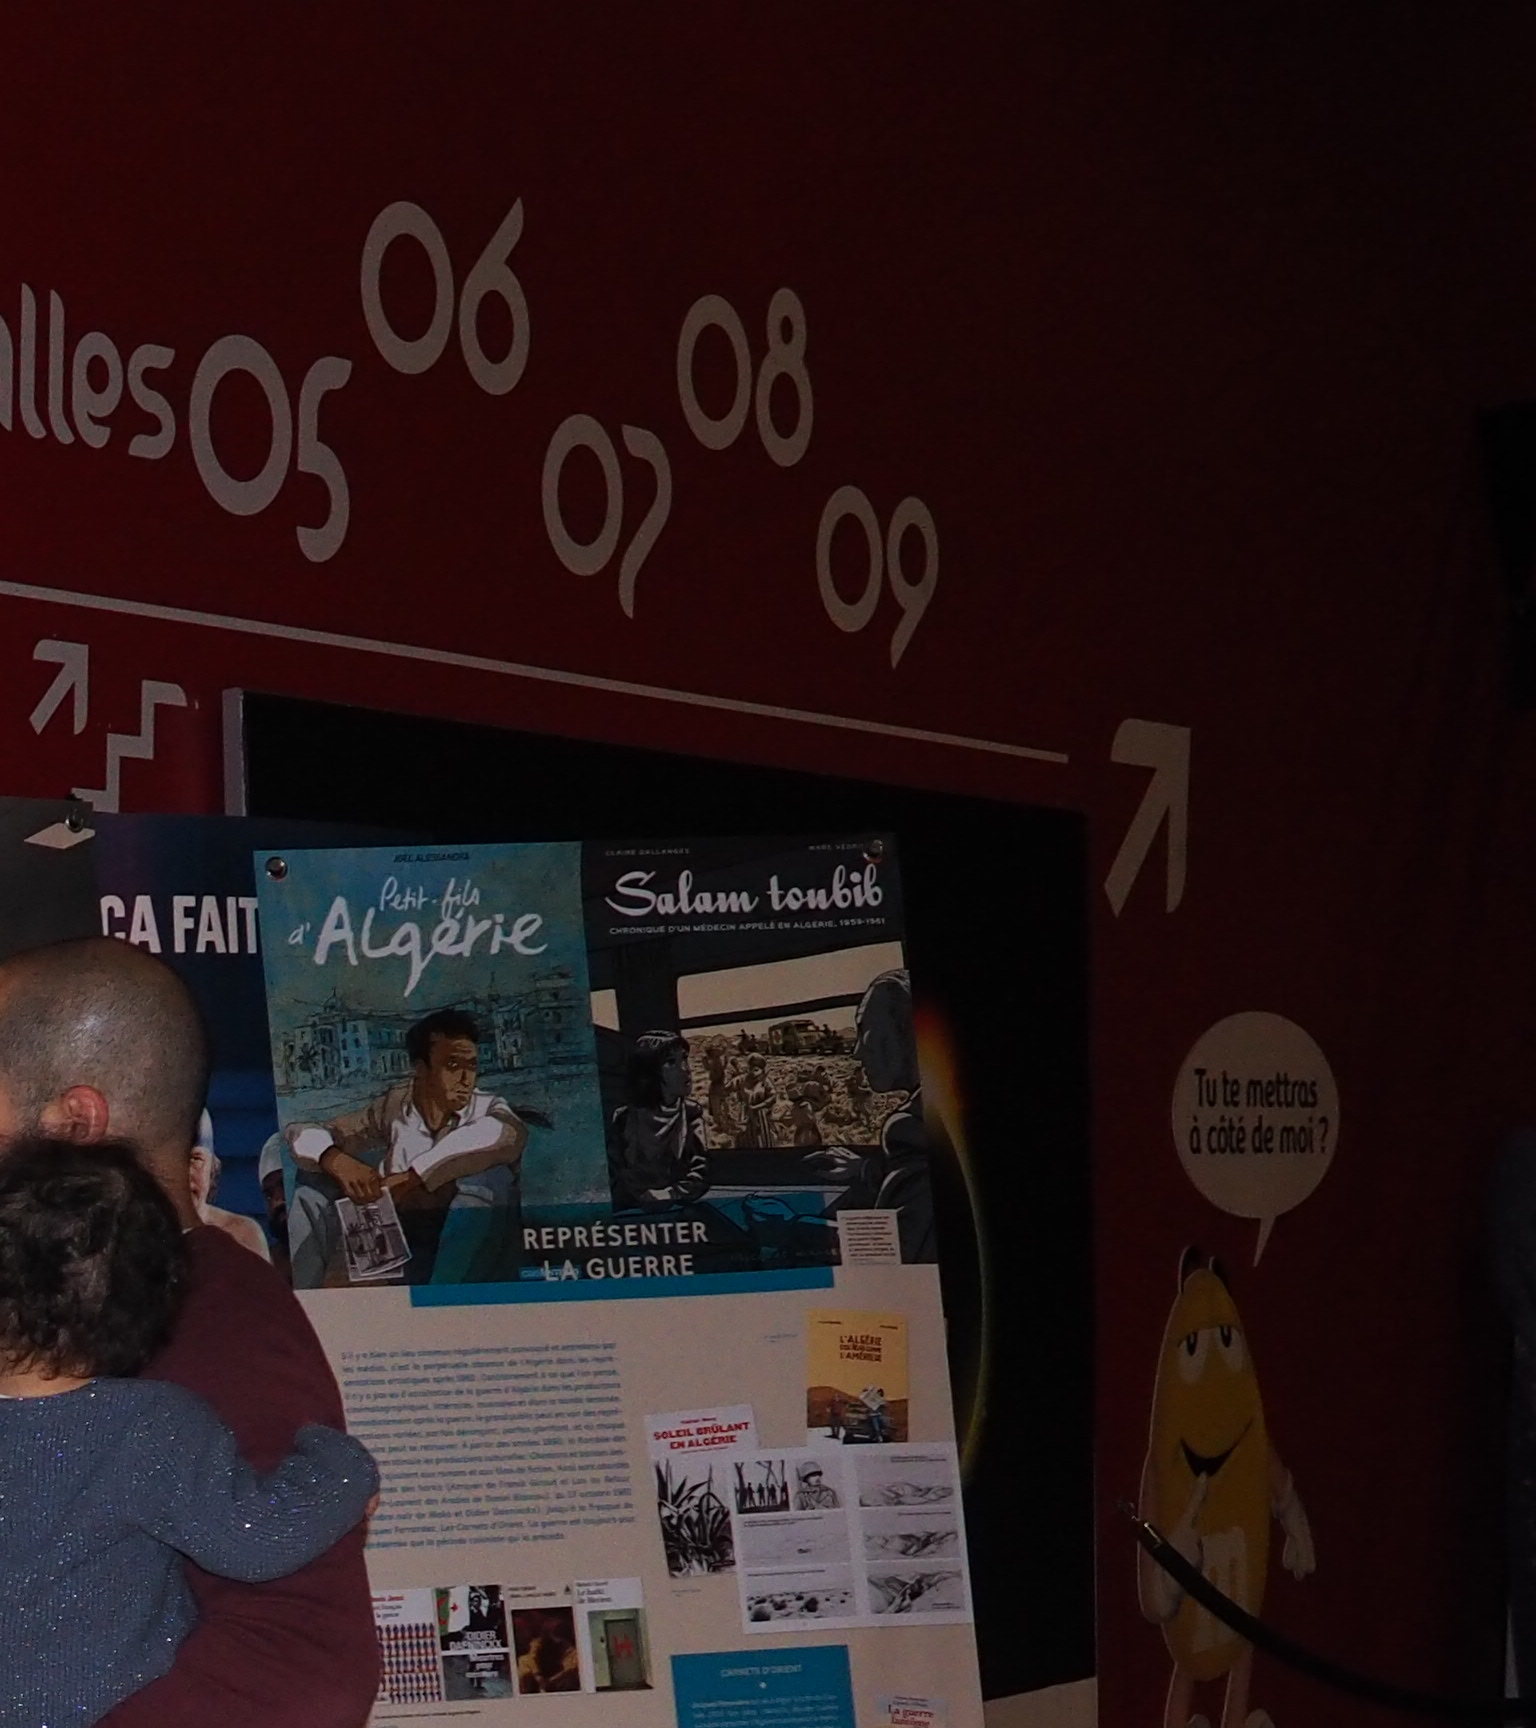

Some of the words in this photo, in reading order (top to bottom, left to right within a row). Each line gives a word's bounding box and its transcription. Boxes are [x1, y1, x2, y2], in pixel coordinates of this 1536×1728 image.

[360, 195, 530, 397] 06
[677, 286, 814, 468] 08
[188, 334, 353, 563] 05
[541, 412, 673, 620] 07
[815, 484, 939, 670] 09
[605, 869, 759, 917] Salam
[766, 863, 883, 911] toubib
[173, 895, 258, 954] FAIT
[1194, 1068, 1216, 1107] Tu
[1222, 1070, 1240, 1107] te
[1246, 1071, 1317, 1108] mettras
[1190, 1115, 1201, 1154] à
[1207, 1114, 1246, 1154] côté
[1252, 1115, 1274, 1154] de
[1279, 1116, 1314, 1154] moi
[522, 1219, 709, 1251] REPRÉSENTER
[542, 1258, 579, 1282] LA
[585, 1253, 695, 1281] GUERRE
[653, 1428, 691, 1441] SOLEIL
